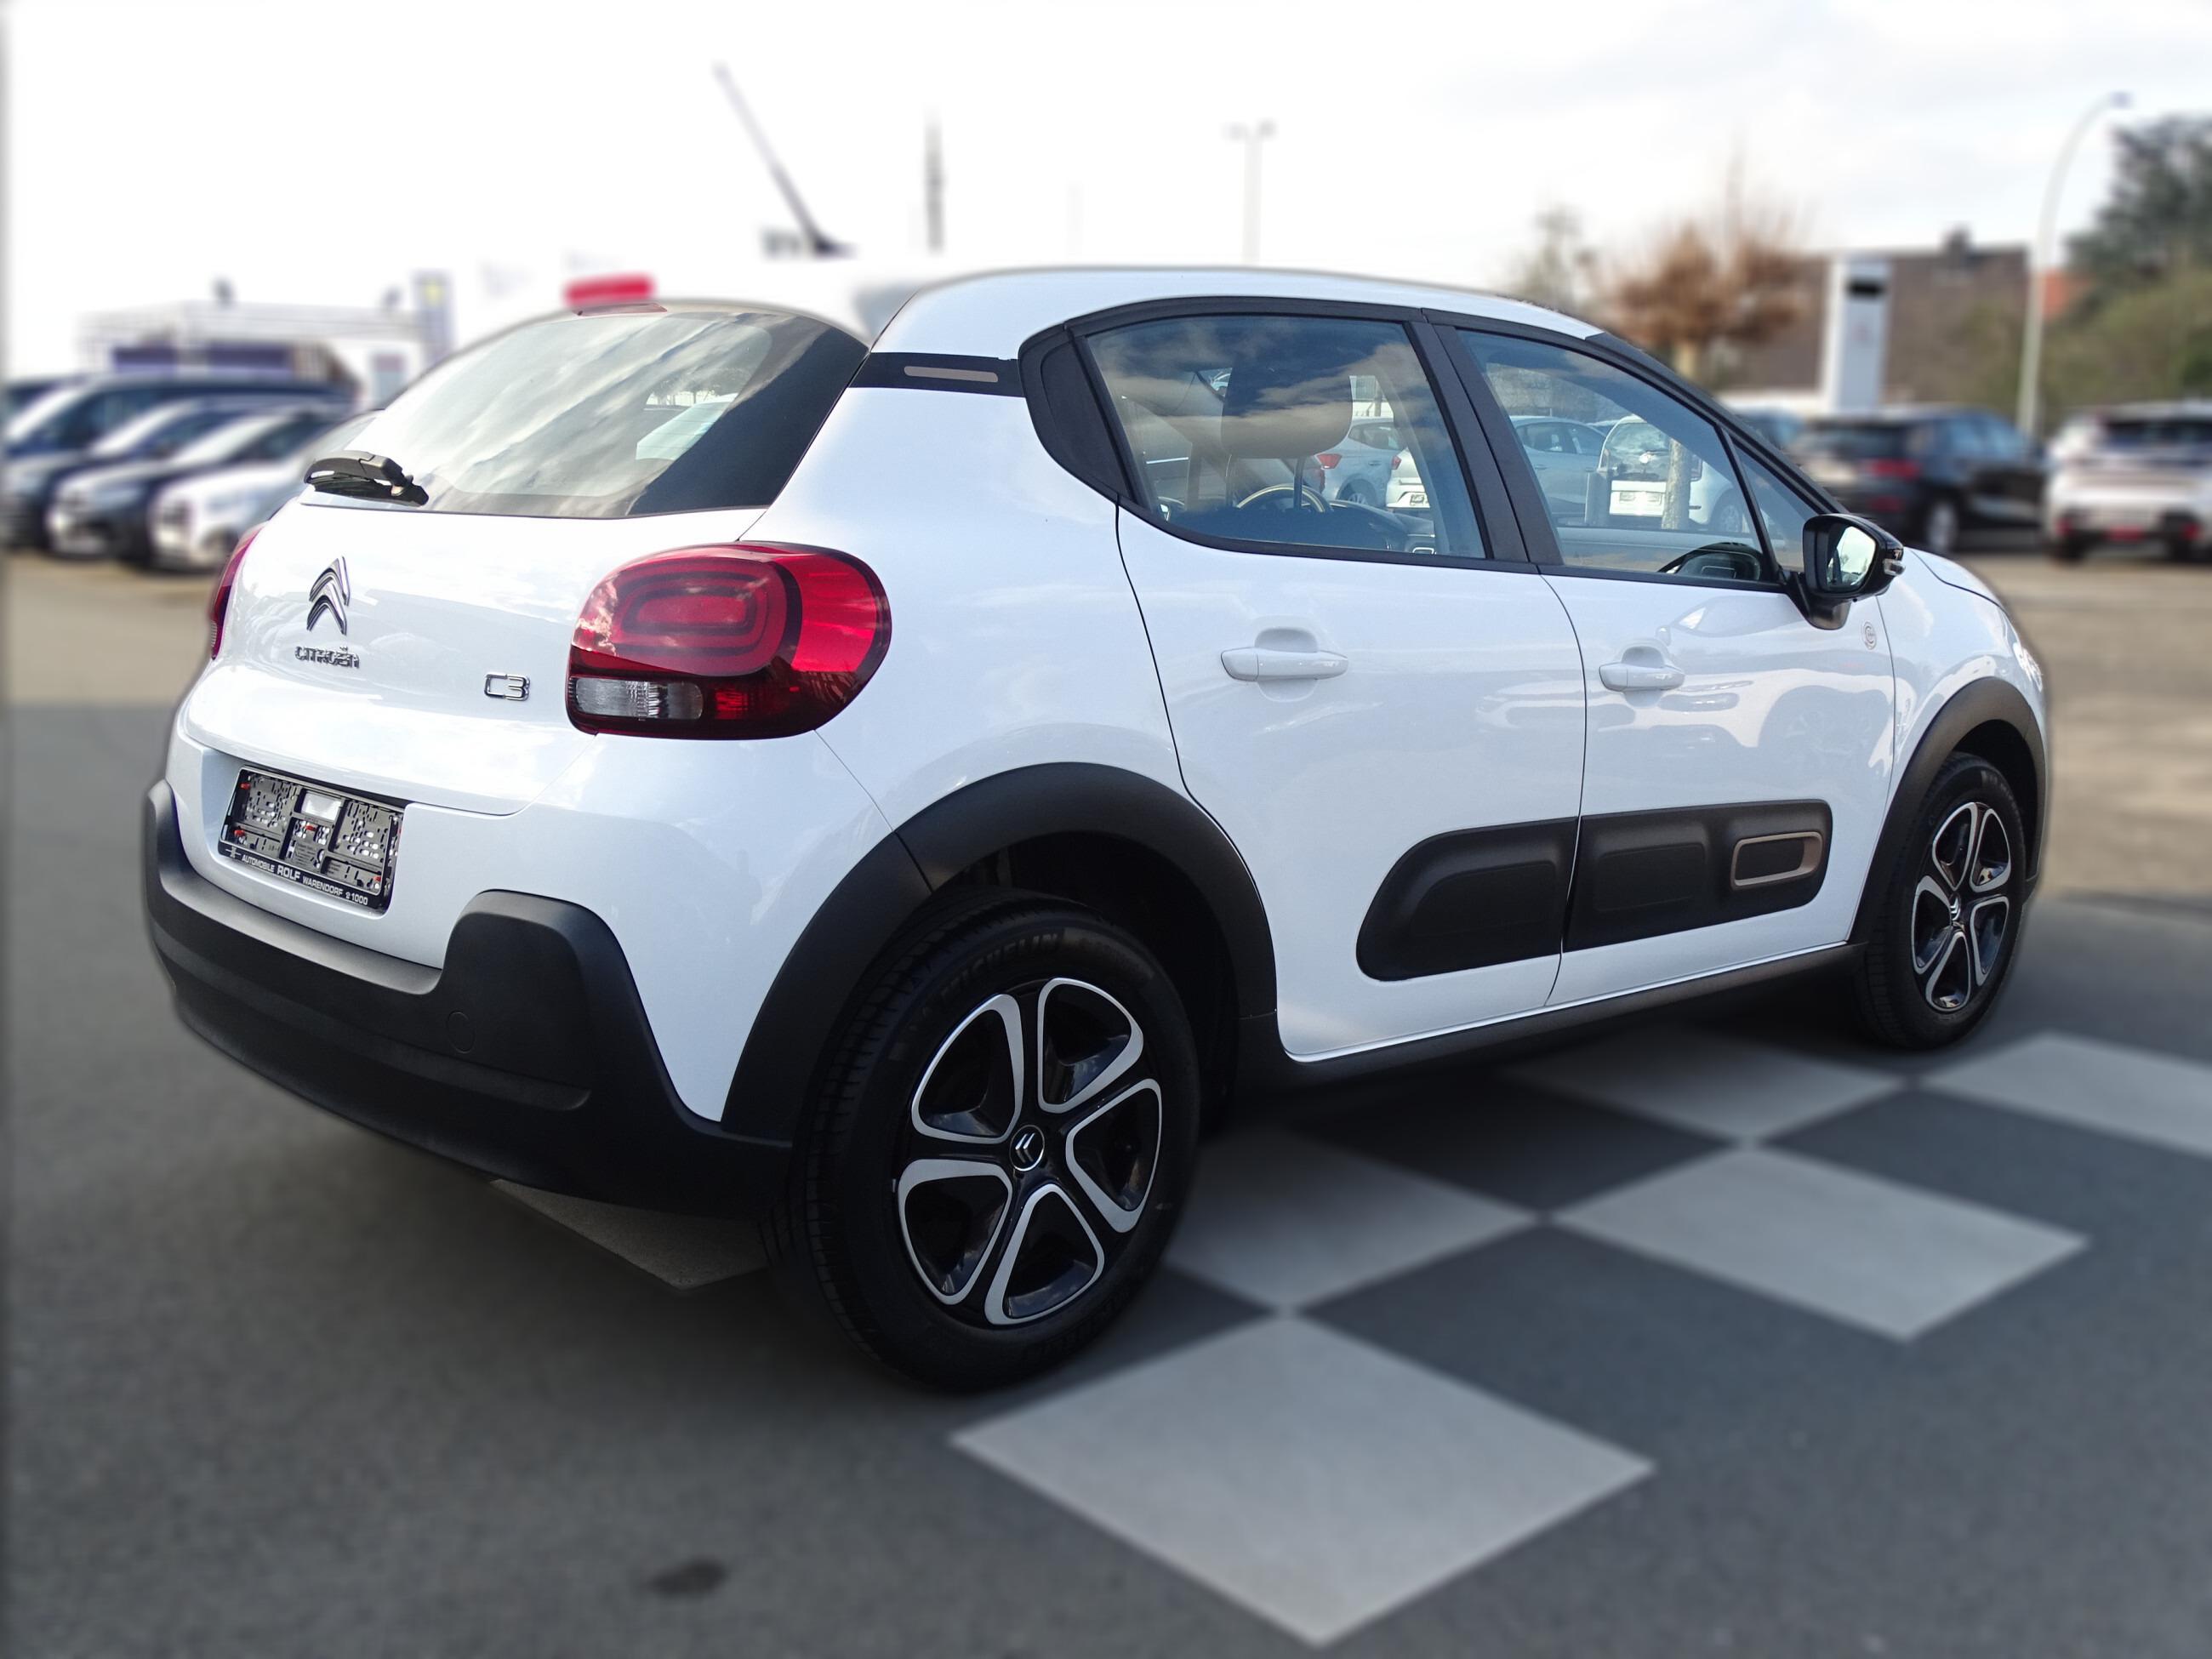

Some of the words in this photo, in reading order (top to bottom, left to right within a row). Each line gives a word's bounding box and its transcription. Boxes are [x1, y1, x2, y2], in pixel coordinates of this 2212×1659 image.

[483, 672, 531, 702] C3
[242, 854, 275, 873] AUTOMOBILE
[276, 864, 301, 881] ROLF
[302, 875, 344, 896] WARENDORF
